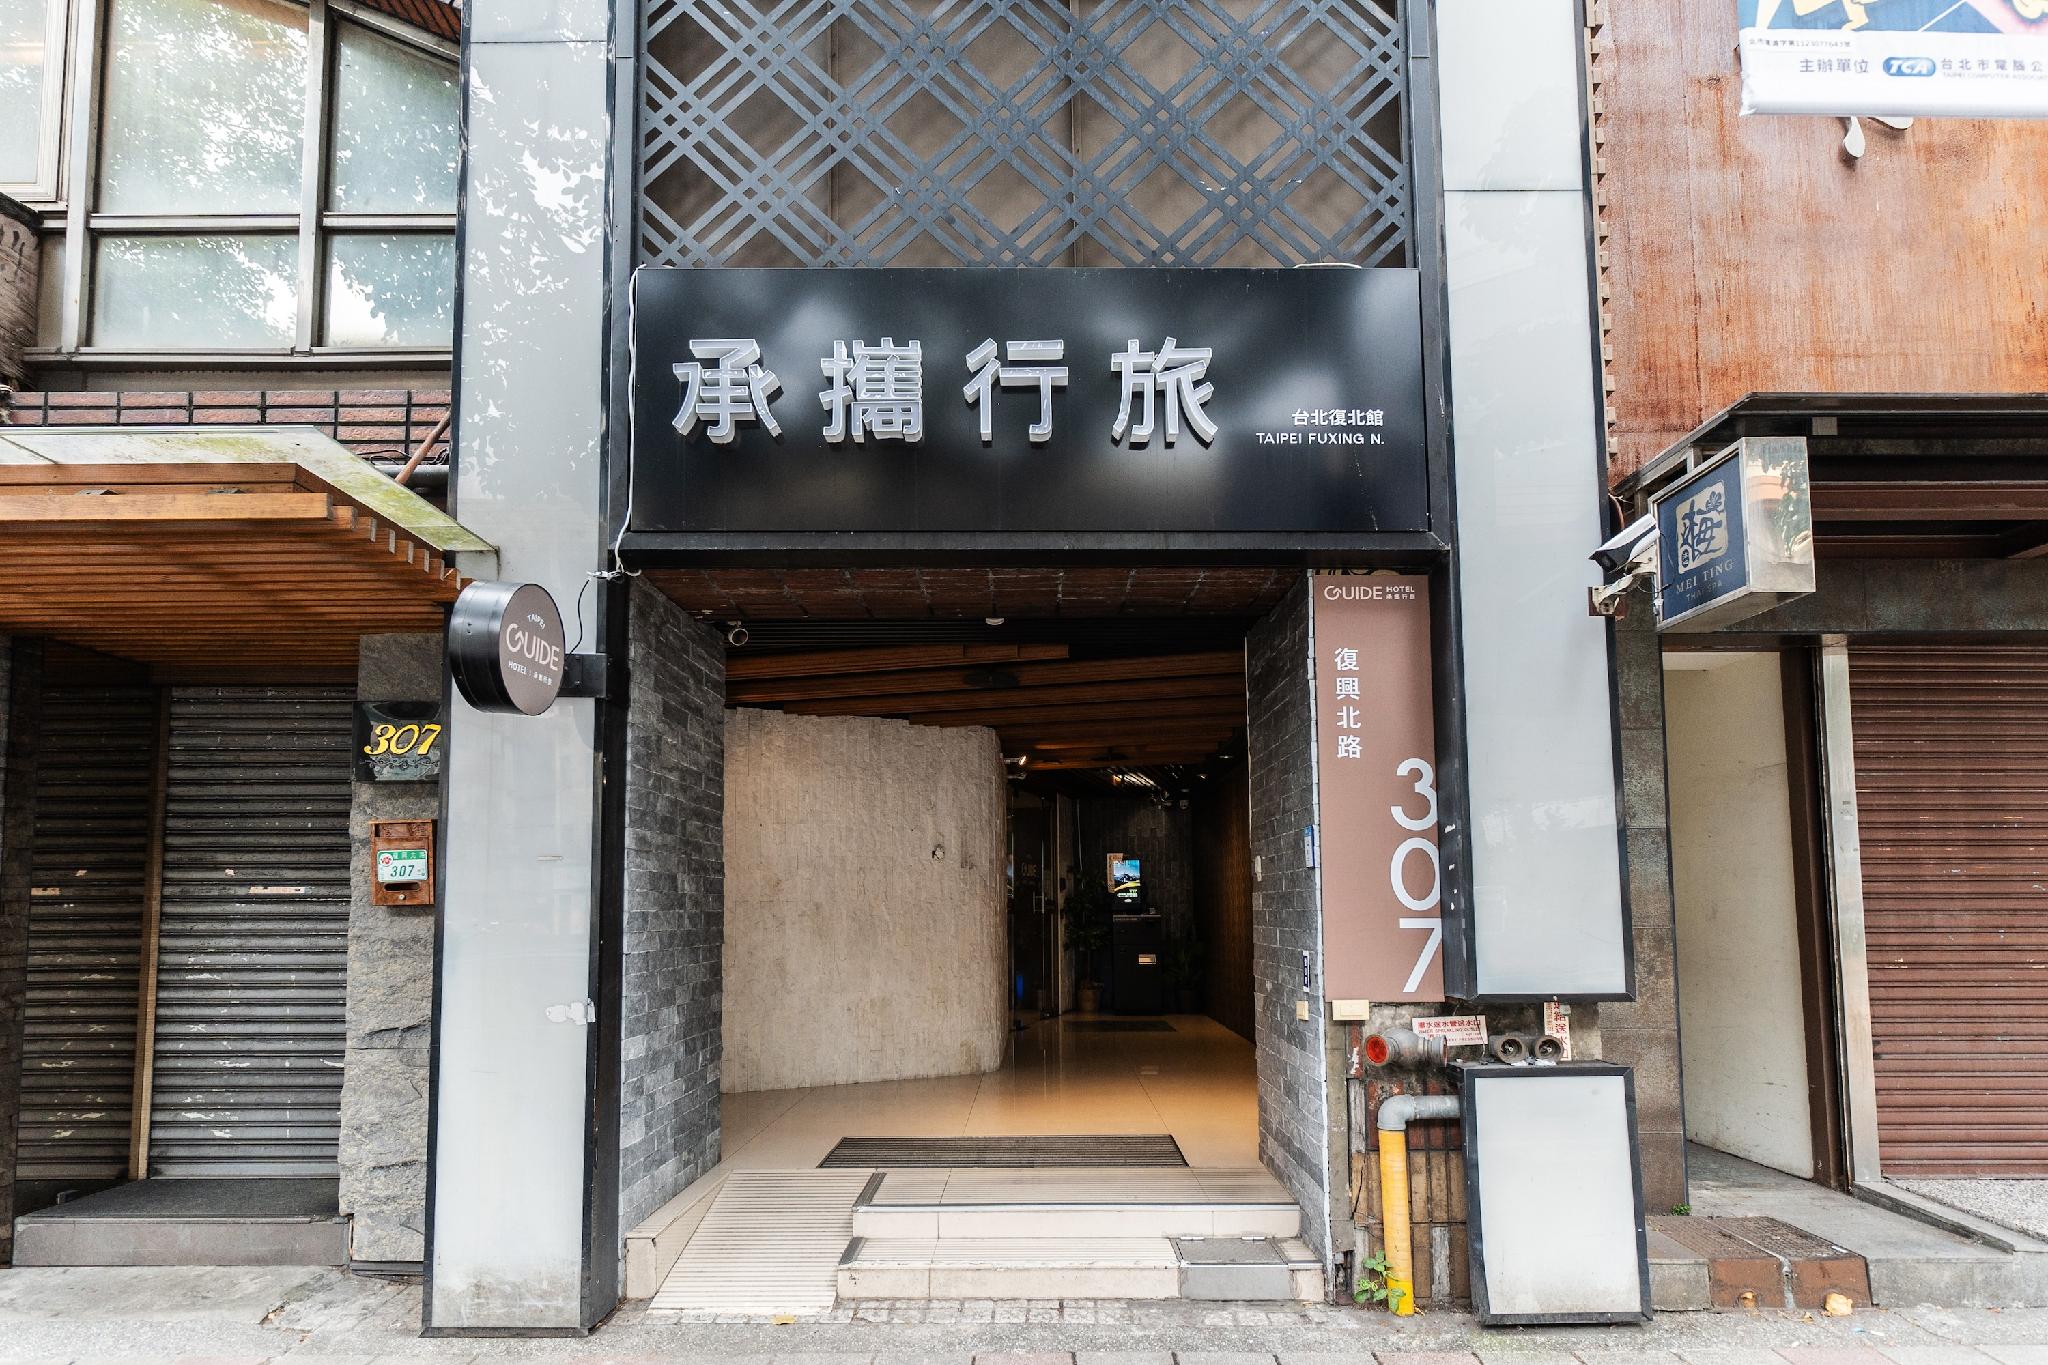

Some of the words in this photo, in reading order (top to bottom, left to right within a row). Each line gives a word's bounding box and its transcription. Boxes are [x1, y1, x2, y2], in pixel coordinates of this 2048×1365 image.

[1799, 58, 1870, 74] 主辦單位
[1888, 59, 1930, 75] TCA
[671, 336, 1220, 446] 承攜行旅
[1291, 408, 1384, 427] 台北復北館
[1256, 432, 1302, 445] TAIPEI
[1308, 432, 1365, 445] FUXING
[1370, 433, 1385, 445] N.
[1676, 575, 1698, 595] MEI
[1703, 559, 1734, 582] TING
[1324, 585, 1383, 600] GUIDE
[1386, 585, 1415, 593] HOTEL
[527, 613, 546, 630] TAIPEI
[506, 623, 560, 672] GUIDE
[508, 660, 527, 675] HOTEL
[1334, 647, 1363, 759] 復興北路
[363, 723, 442, 756] 307
[390, 864, 415, 877] 307
[1390, 757, 1443, 993] 307
